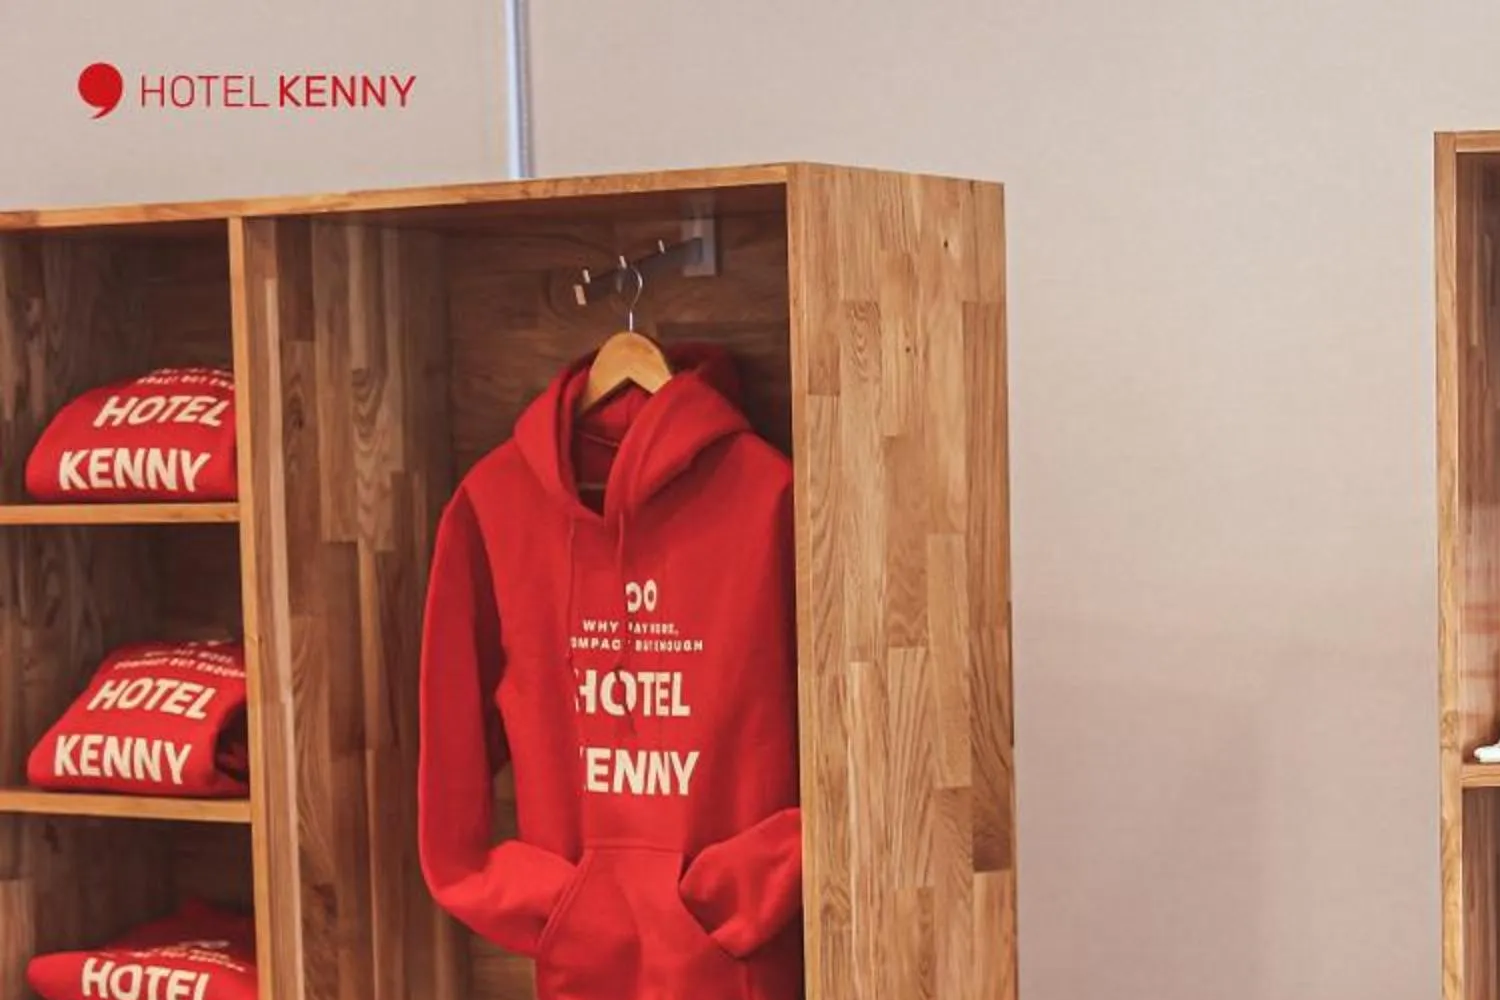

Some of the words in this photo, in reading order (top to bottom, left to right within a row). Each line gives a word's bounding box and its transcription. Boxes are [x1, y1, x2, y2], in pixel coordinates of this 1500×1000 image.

[93, 395, 229, 427] HOTEL
[58, 447, 211, 492] KENNY
[582, 619, 619, 634] WHY
[87, 677, 217, 720] HOTEL
[573, 668, 691, 717] HOTEL
[54, 734, 193, 785] KENNY
[579, 745, 701, 796] ENNY
